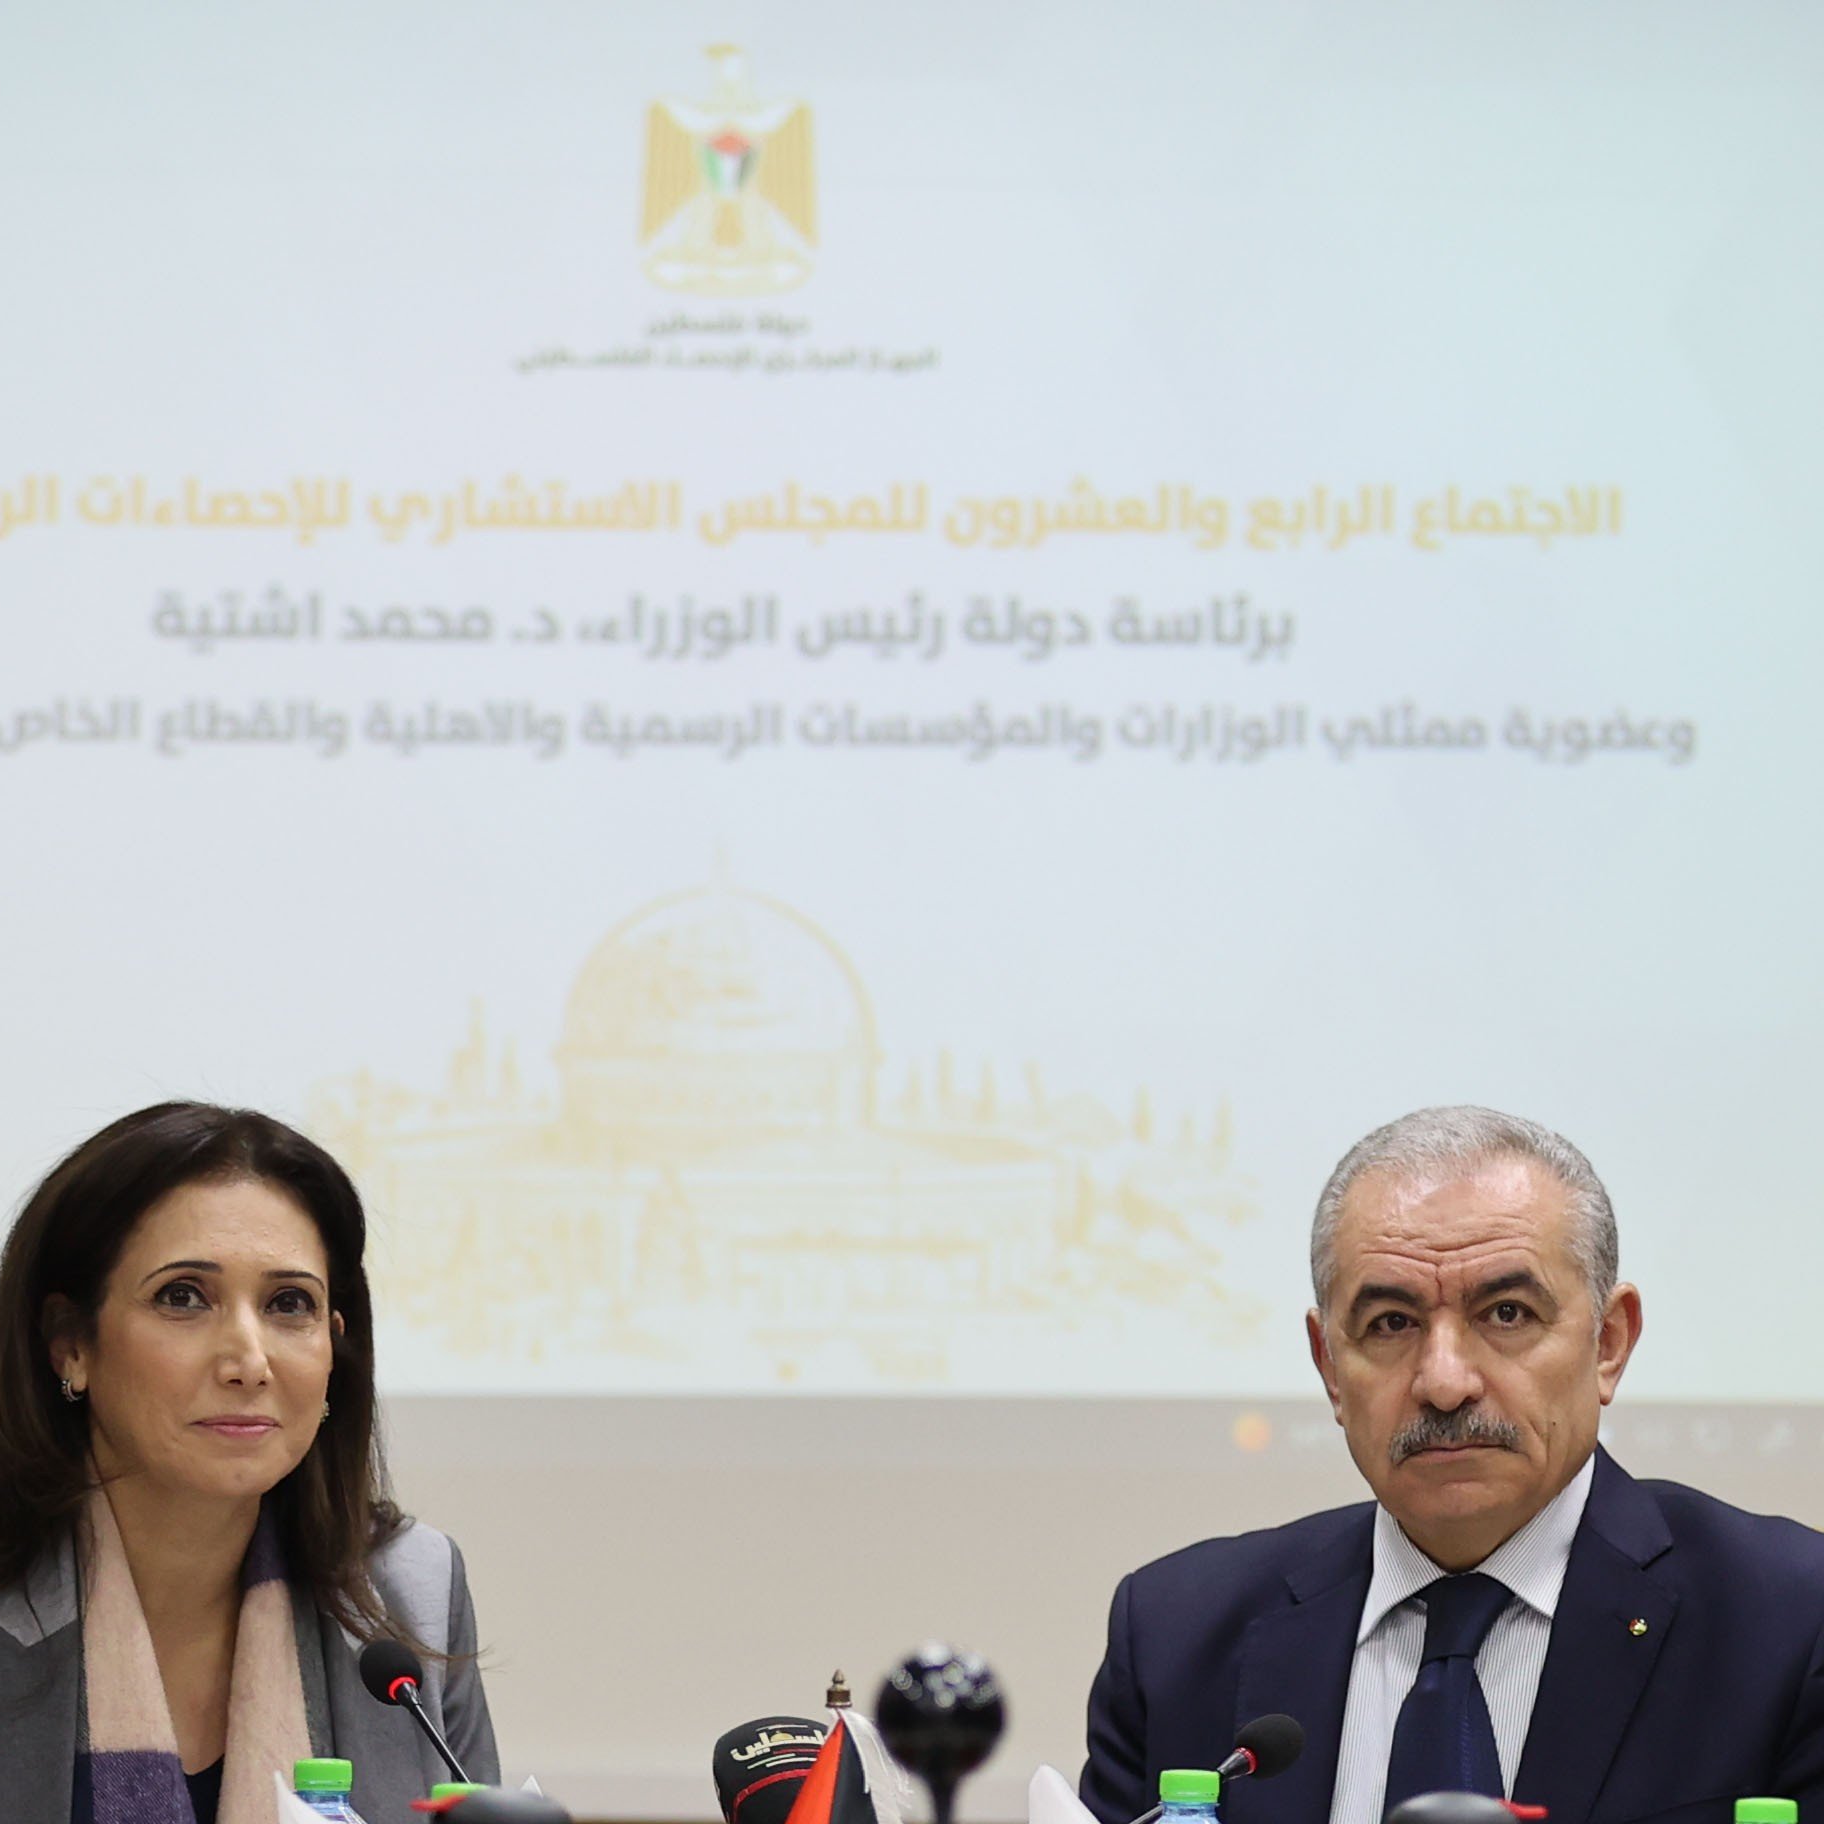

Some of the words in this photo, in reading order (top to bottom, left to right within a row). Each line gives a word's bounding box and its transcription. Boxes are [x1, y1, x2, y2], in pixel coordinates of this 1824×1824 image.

[77, 478, 349, 544] للإحصاءات
[369, 475, 681, 543] الاستشاري
[699, 483, 926, 545] للمجلس
[944, 479, 1227, 548] والعشرون
[1247, 487, 1392, 548] الرابع
[1412, 487, 1621, 549] الاجتماع
[151, 583, 322, 654] اشتية
[340, 605, 496, 643] محمد
[511, 607, 562, 644] د.
[794, 589, 946, 661] رئيس
[961, 596, 1091, 662] دولة
[1106, 593, 1295, 662] برئاسة
[155, 699, 350, 758] والقطاع
[579, 703, 781, 760] الرسمية
[797, 702, 1104, 762] والمؤسسات
[1116, 706, 1307, 764] الوزارات
[1319, 705, 1486, 761] ممثلي
[1501, 709, 1696, 765] وعضوية
[729, 1728, 829, 1762] لسطين
